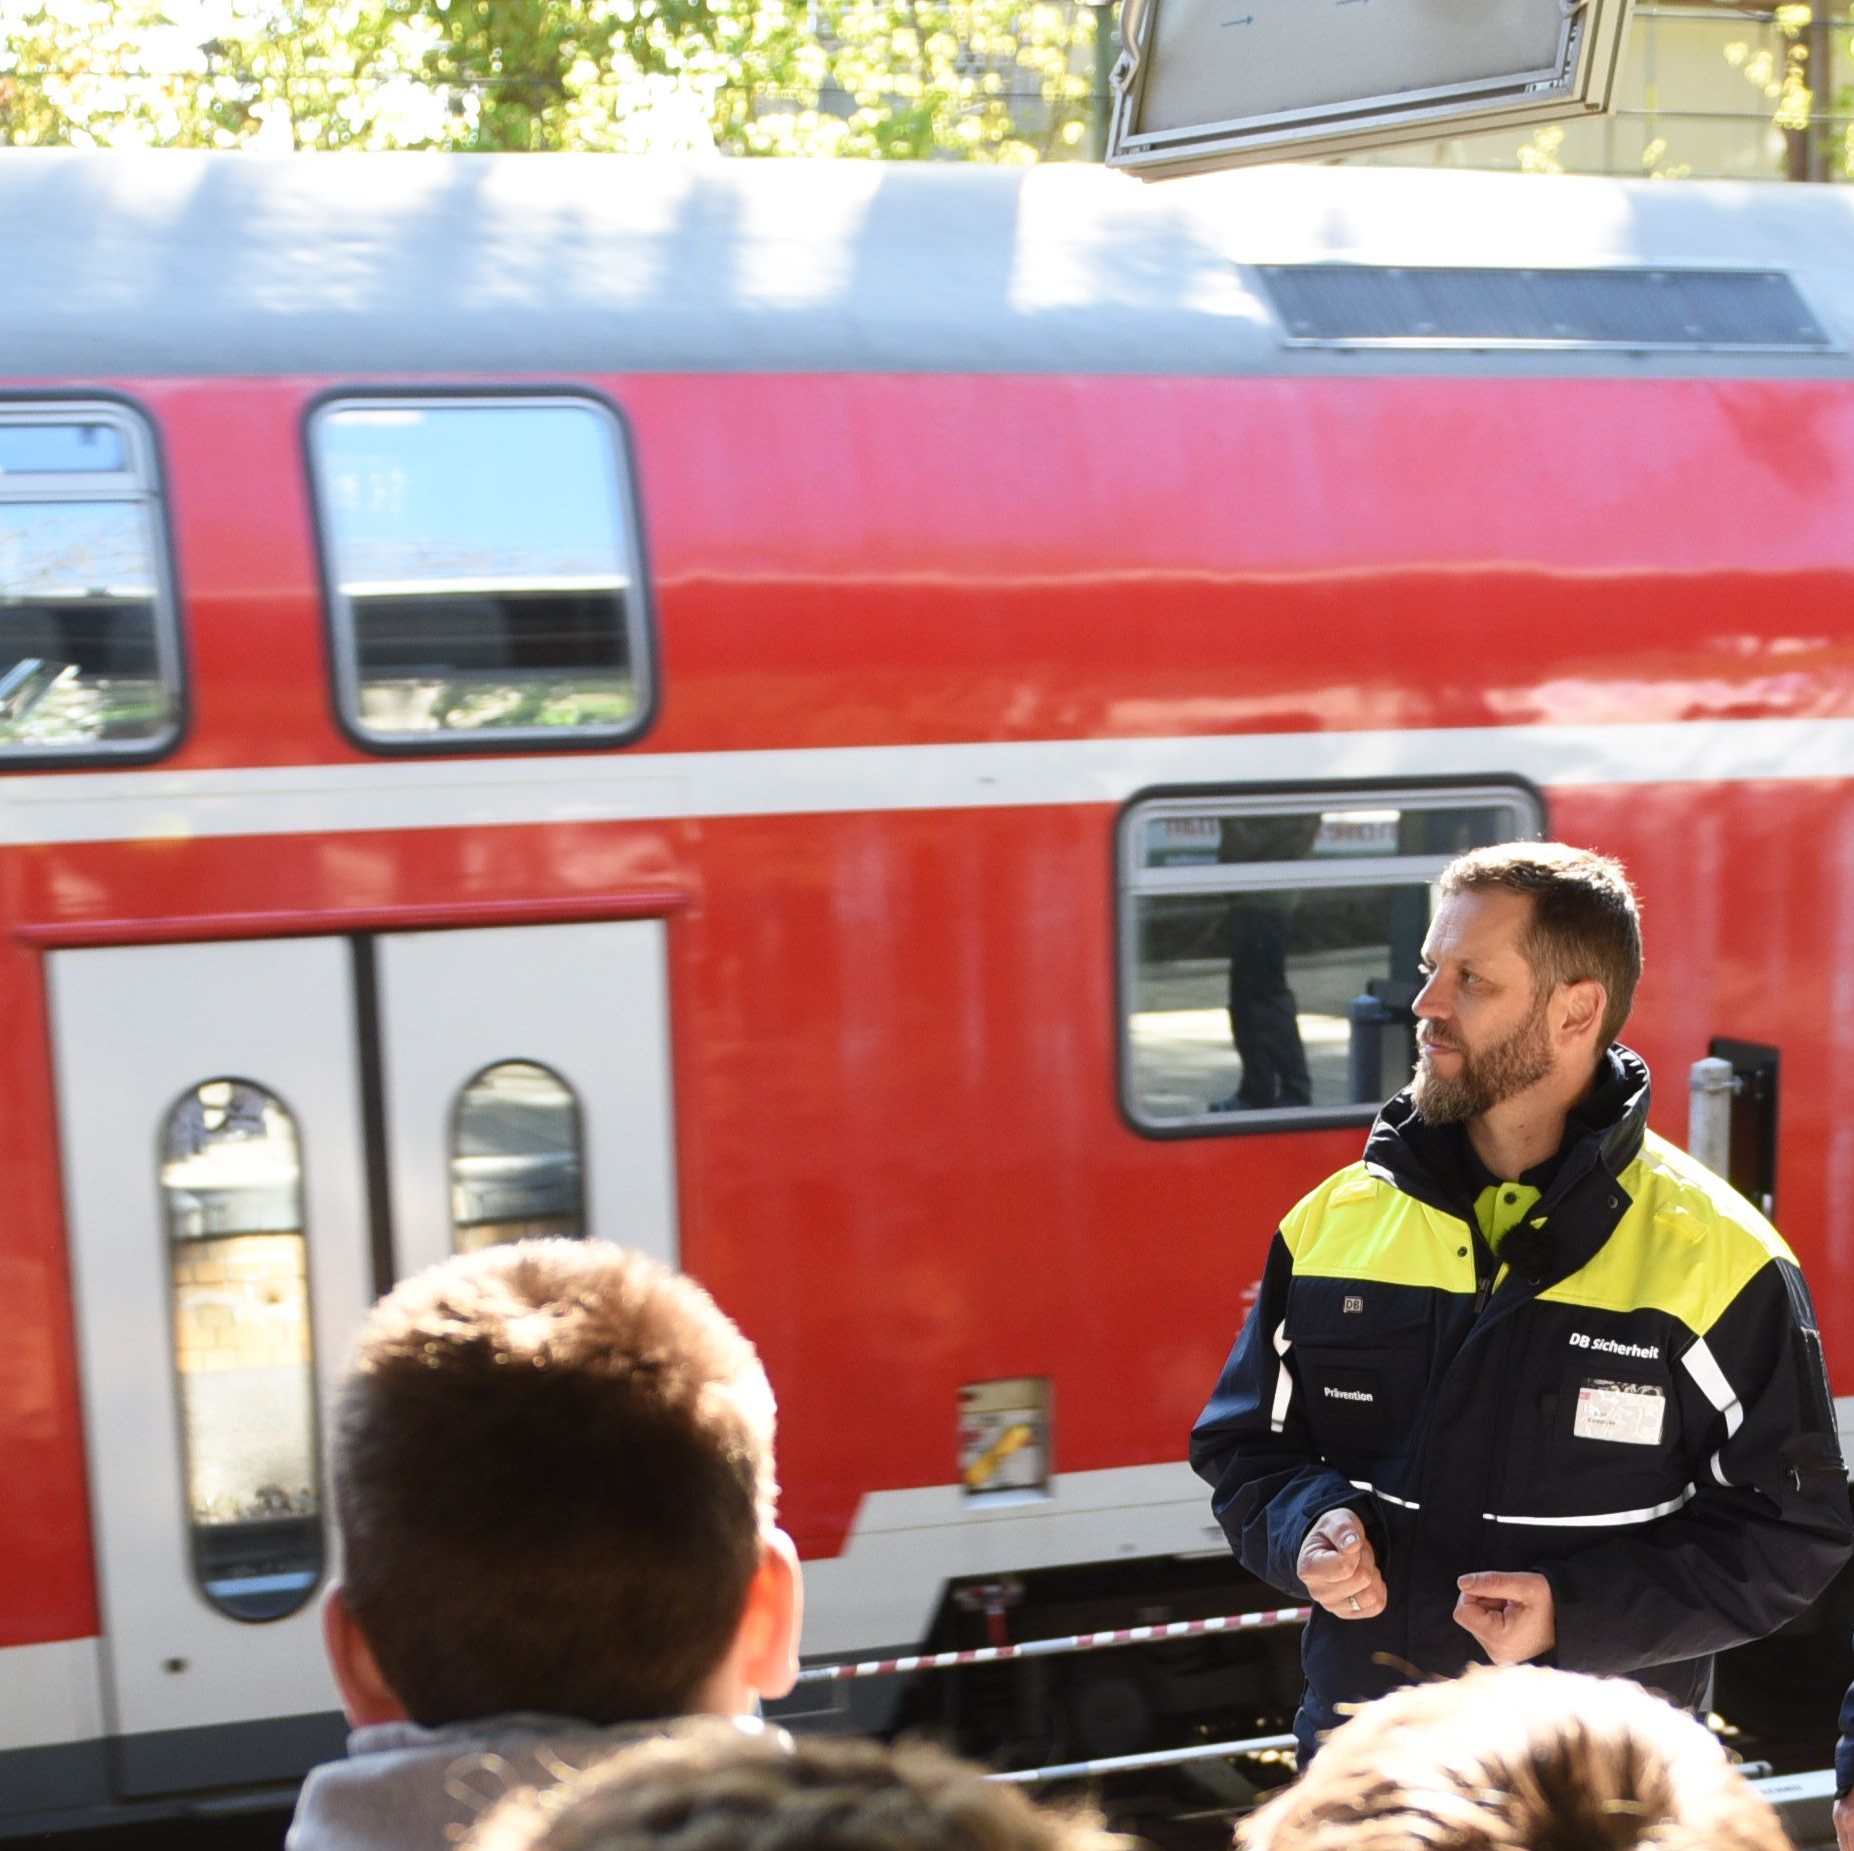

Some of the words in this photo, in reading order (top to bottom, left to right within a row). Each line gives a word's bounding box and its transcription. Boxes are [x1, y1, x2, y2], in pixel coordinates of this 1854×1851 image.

[1569, 1333, 1591, 1349] DB
[1591, 1338, 1660, 1359] Sicherheit
[1324, 1387, 1373, 1402] Prävention
